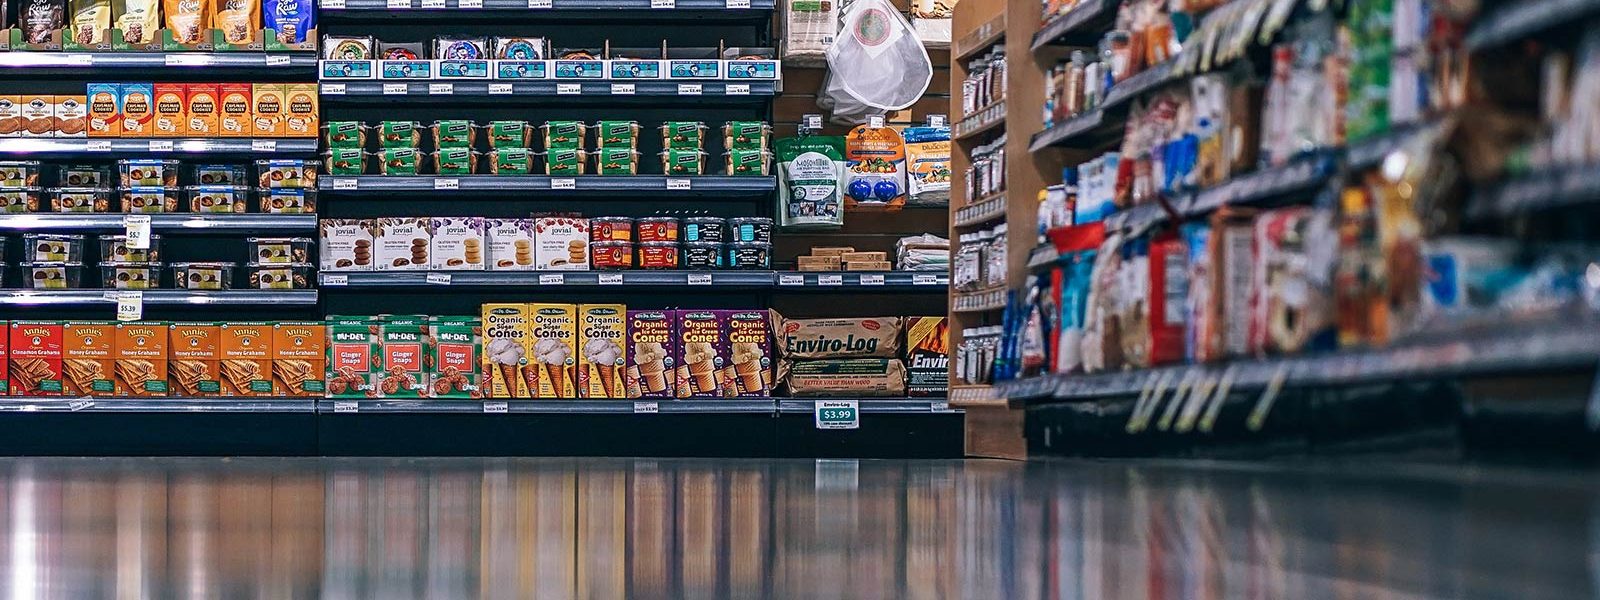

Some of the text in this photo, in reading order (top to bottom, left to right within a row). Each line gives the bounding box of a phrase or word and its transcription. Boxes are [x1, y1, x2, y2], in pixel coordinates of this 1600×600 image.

[29, 3, 51, 16] Raw
[276, 2, 298, 16] Raw
[335, 228, 356, 236] jovial
[392, 227, 412, 235] jovial
[446, 227, 466, 235] jovial
[497, 228, 517, 236] jovial
[551, 228, 571, 236] jovial
[488, 316, 522, 324] Organic
[535, 316, 569, 324] Organic
[586, 316, 619, 324] Organic
[634, 320, 668, 329] Organic
[684, 320, 718, 329] Organic
[731, 320, 764, 329] Organic
[24, 328, 50, 336] Annie's
[76, 328, 102, 336] Annie's
[128, 328, 155, 336] Annie's
[182, 328, 208, 337] Annie's
[234, 328, 260, 337] Annie's
[286, 328, 312, 337] Annie's
[488, 328, 523, 338] Cones
[534, 328, 570, 338] Cones
[585, 328, 620, 338] Cones
[633, 332, 668, 342] Cones
[683, 332, 718, 342] Cones
[730, 332, 765, 342] Cones
[786, 334, 878, 354] Enviro-Log
[824, 410, 851, 419] $3.99
